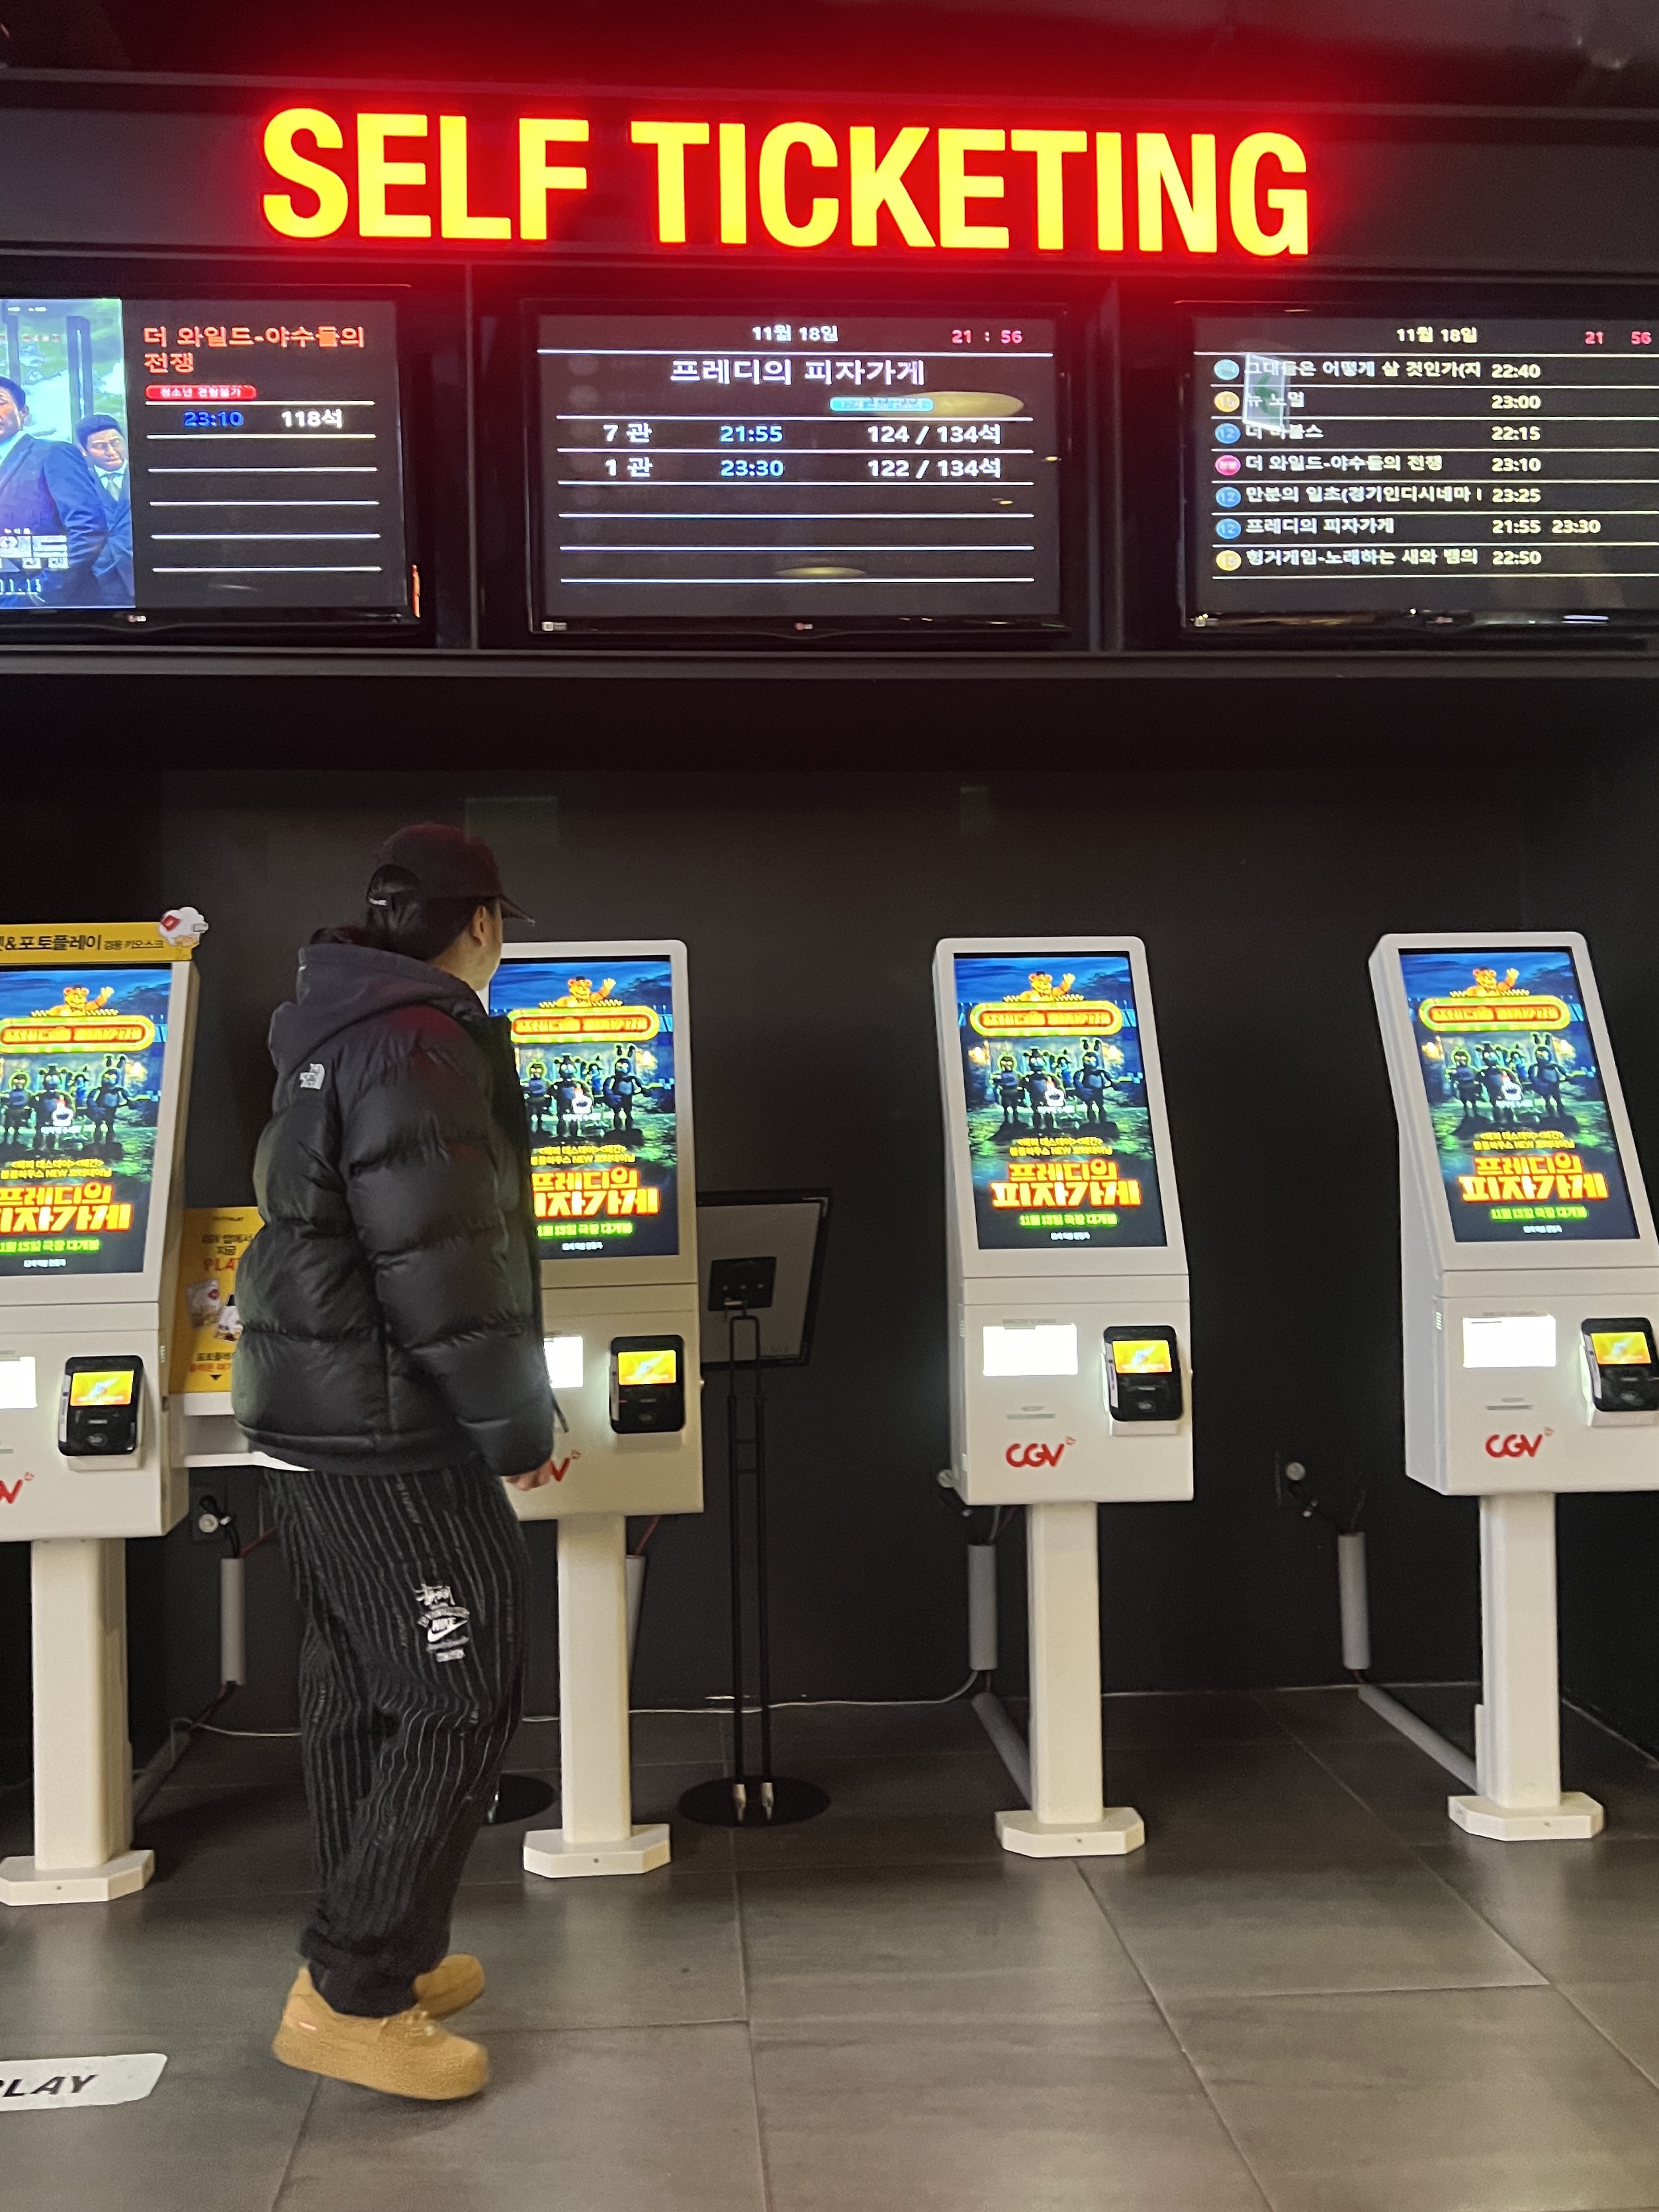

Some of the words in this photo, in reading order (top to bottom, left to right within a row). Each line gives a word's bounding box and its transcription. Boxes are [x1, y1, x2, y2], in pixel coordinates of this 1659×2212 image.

[263, 107, 590, 240] SELF
[630, 121, 1310, 256] TICKETING
[144, 326, 167, 347] 더
[177, 326, 365, 348] 와일드-야수들의
[752, 324, 793, 342] 11월
[798, 325, 838, 342] 18일
[952, 329, 972, 344] 21
[1001, 329, 1023, 344] 56
[1397, 326, 1434, 343] 11월
[1441, 326, 1478, 343] 18일
[1585, 331, 1604, 345] 21
[1631, 331, 1652, 345] 56
[144, 352, 195, 374] 전쟁
[670, 358, 793, 387] 프레디의
[804, 359, 926, 387] 피자가게
[1322, 361, 1375, 377] 어떻게
[1491, 364, 1541, 378] 22:40
[1491, 395, 1541, 409] 23:00
[183, 410, 244, 428] 23:10
[282, 408, 344, 429] 118석
[603, 424, 619, 442] 7
[626, 422, 652, 443] 관
[719, 425, 784, 443] 21:55
[868, 426, 910, 443] 124
[915, 426, 930, 445] /
[937, 424, 1001, 445] 134석
[1492, 426, 1541, 440] 22:15
[605, 459, 617, 477] 1
[627, 457, 653, 478] 관
[720, 459, 784, 477] 23:30
[868, 459, 910, 477] 122
[915, 459, 930, 479] /
[937, 457, 1001, 479] 134석
[1245, 455, 1263, 471] 더
[1269, 455, 1402, 471] 와일드-야수들의
[1407, 455, 1443, 471] 전쟁
[1492, 457, 1541, 472] 23:10
[1245, 486, 1300, 503] 만분의
[1492, 488, 1541, 502] 23:25
[1245, 518, 1317, 534] 프레디의
[1323, 518, 1394, 534] 피자가게
[1492, 520, 1541, 533] 21:55
[1552, 519, 1601, 533] 23:30
[1401, 549, 1438, 565] 새와
[1443, 549, 1478, 565] 뱀의
[1492, 551, 1542, 565] 22:50
[46, 1169, 68, 1177] NEW
[1009, 1158, 1118, 1182] 프레디의
[1474, 1152, 1583, 1175] 프레디의
[531, 1166, 639, 1191] 프레디의
[1458, 1172, 1609, 1201] 피자가게
[0, 1181, 113, 1207] 프레디의
[991, 1179, 1142, 1208] 피자가게
[203, 1257, 240, 1271] PLA
[1006, 1443, 1065, 1468] CGV
[1486, 1434, 1542, 1458] CGV
